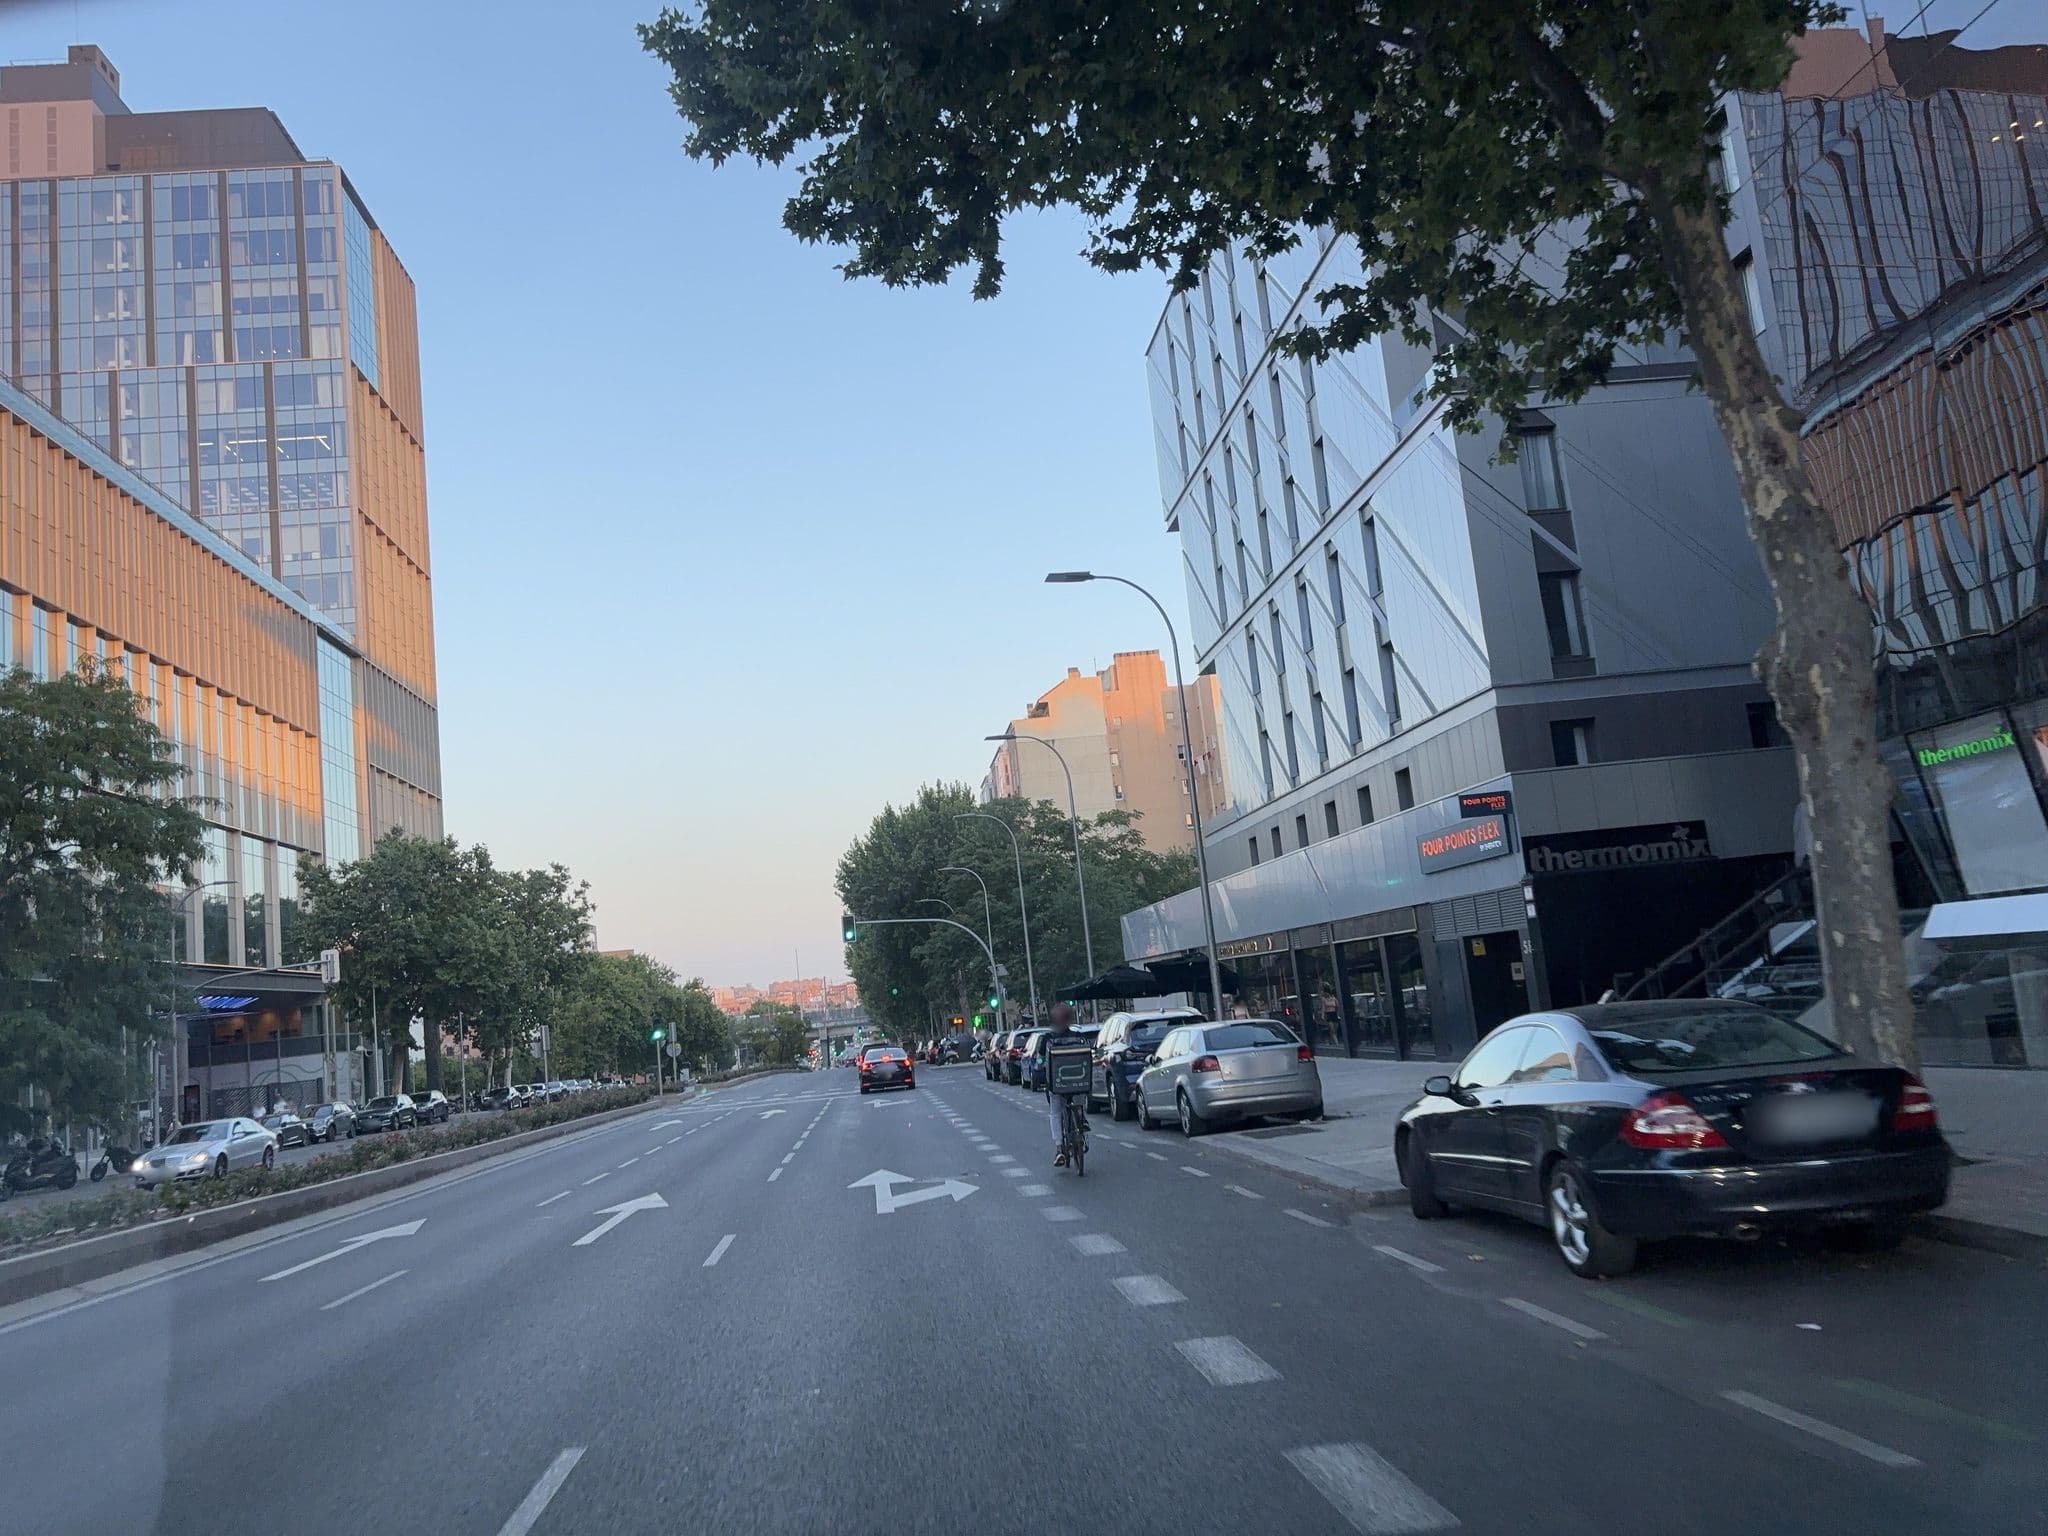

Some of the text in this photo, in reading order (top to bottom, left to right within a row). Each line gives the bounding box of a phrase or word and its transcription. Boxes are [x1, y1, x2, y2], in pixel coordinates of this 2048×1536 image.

[1918, 728, 2016, 767] thermomix
[1422, 838, 1445, 857] FOUR
[1445, 827, 1476, 851] POINTS
[1477, 820, 1500, 842] FLEX
[1529, 826, 1711, 872] thermomix
